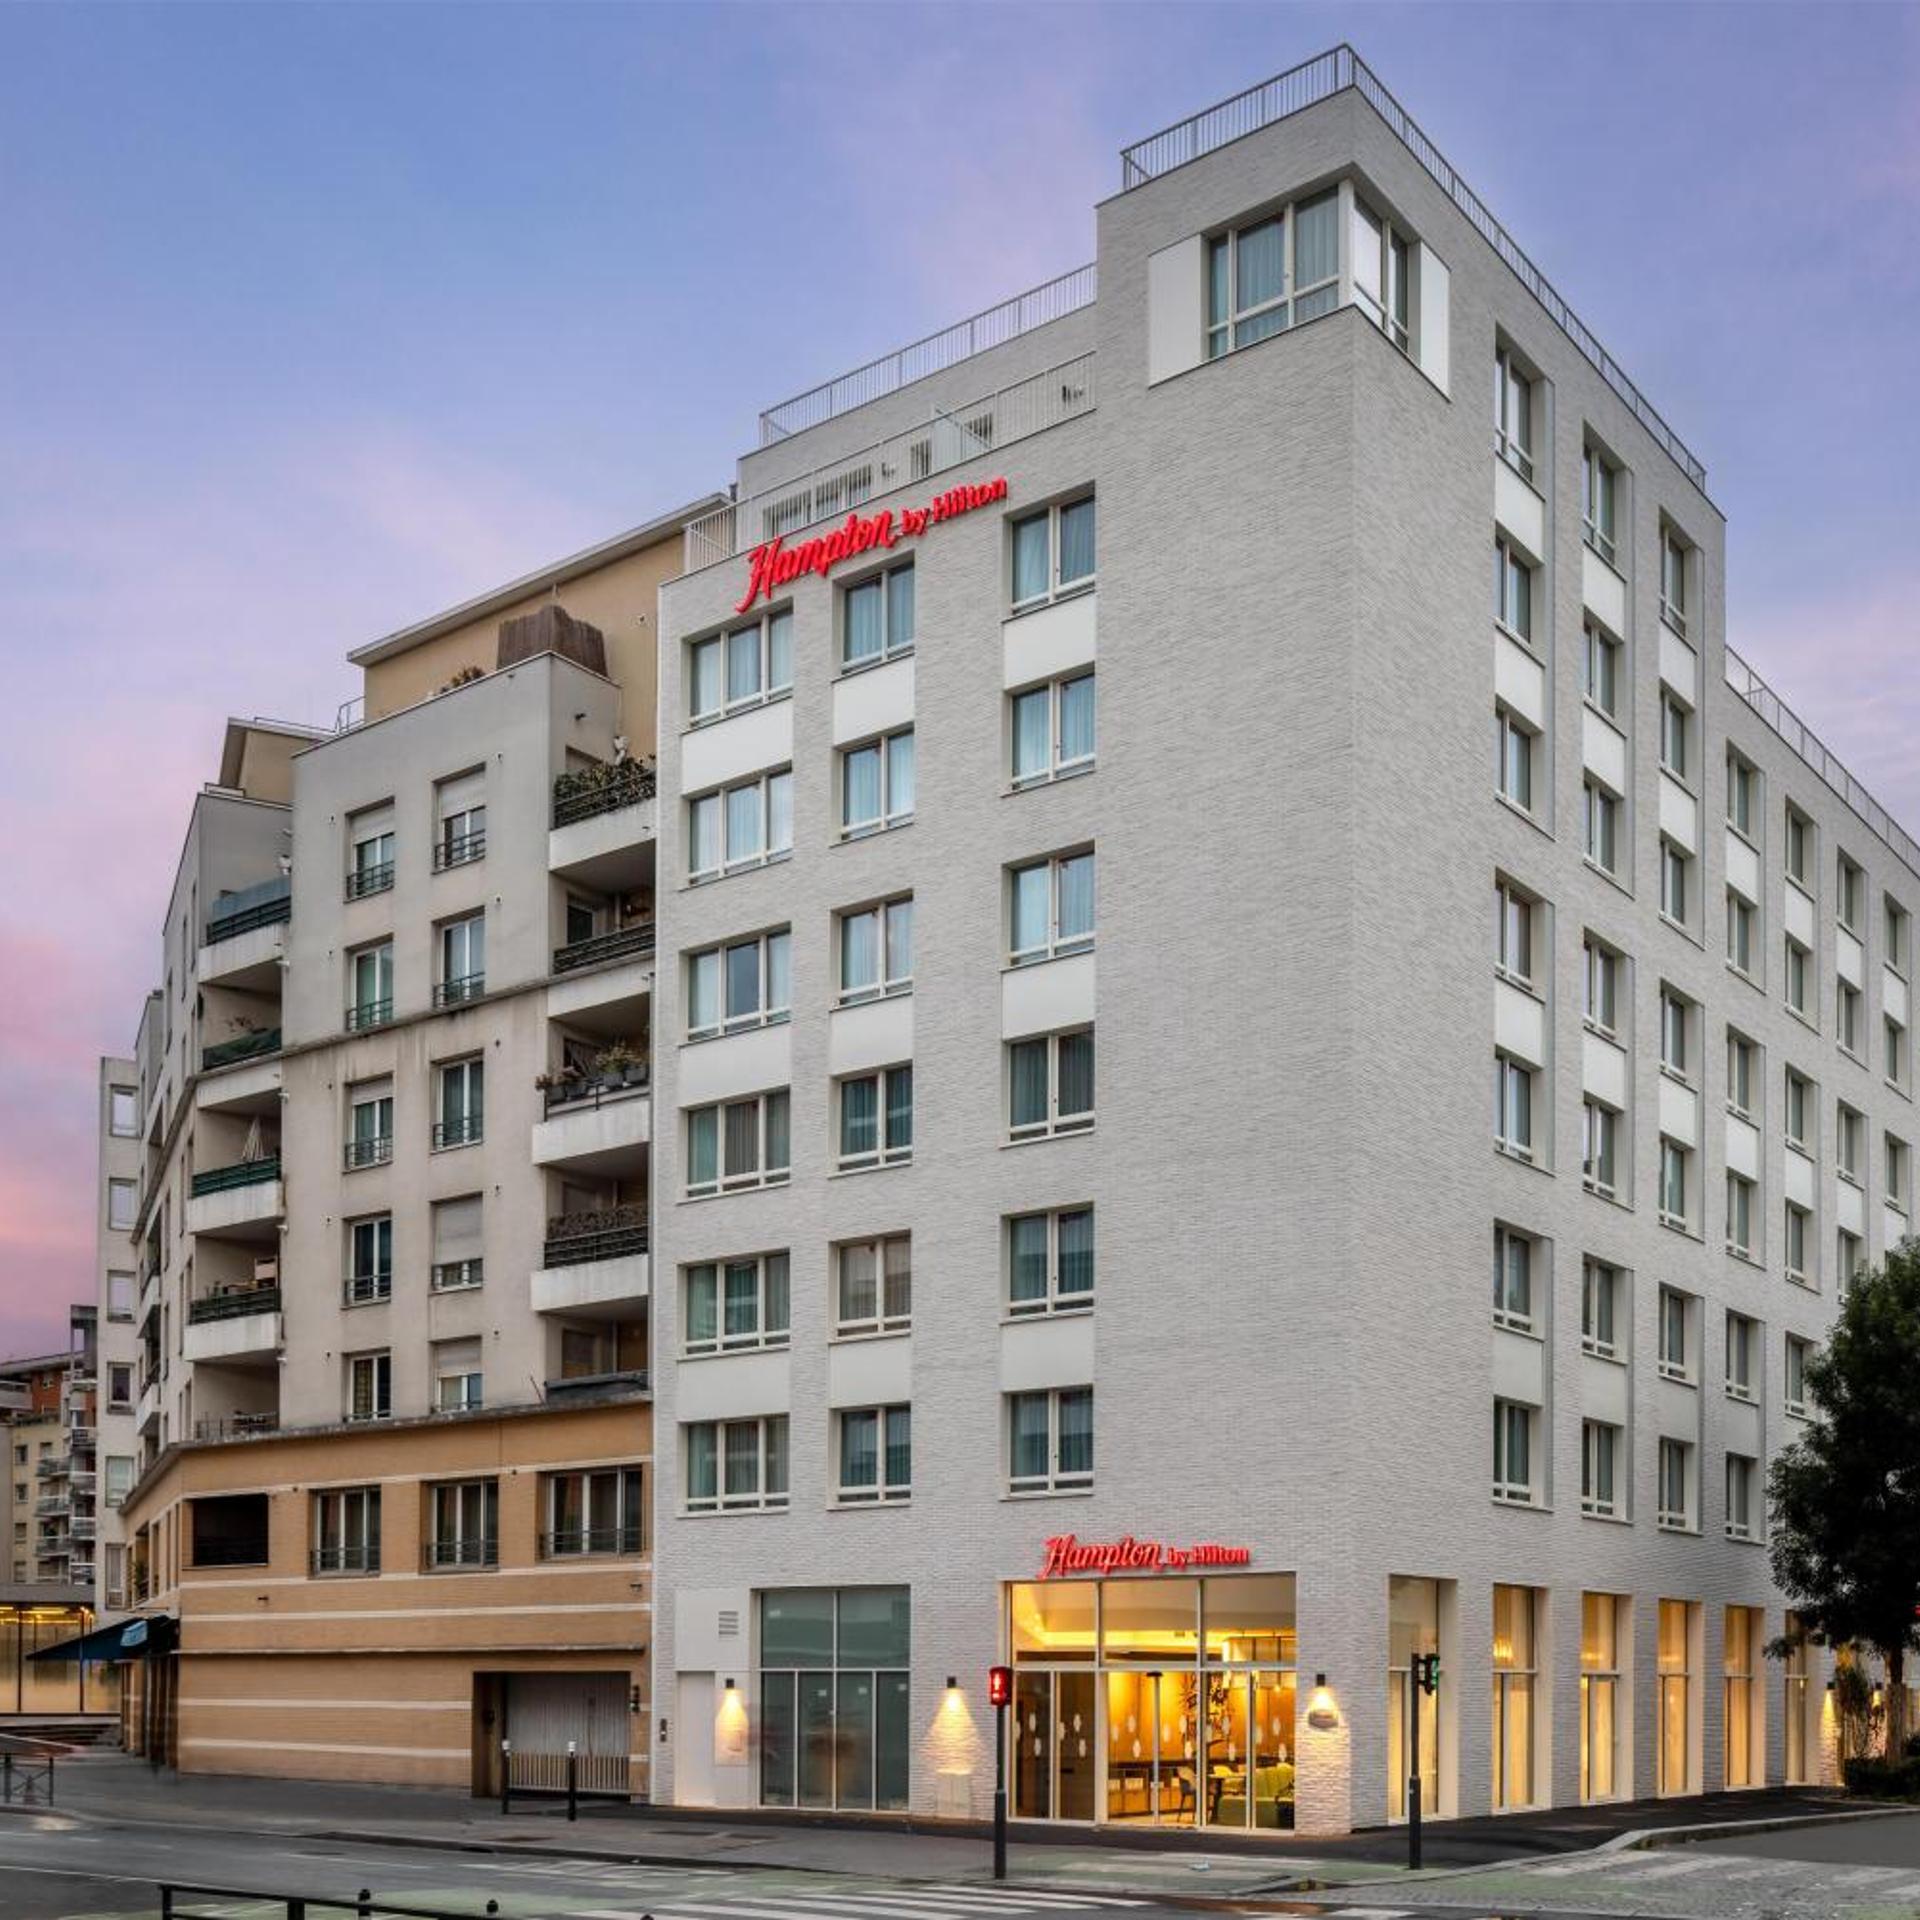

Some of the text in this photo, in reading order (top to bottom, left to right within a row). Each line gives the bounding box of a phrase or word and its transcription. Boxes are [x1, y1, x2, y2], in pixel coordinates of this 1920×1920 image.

[735, 476, 1008, 613] Hampton by Hilton
[1037, 1533, 1250, 1580] Hampton by Hilton
